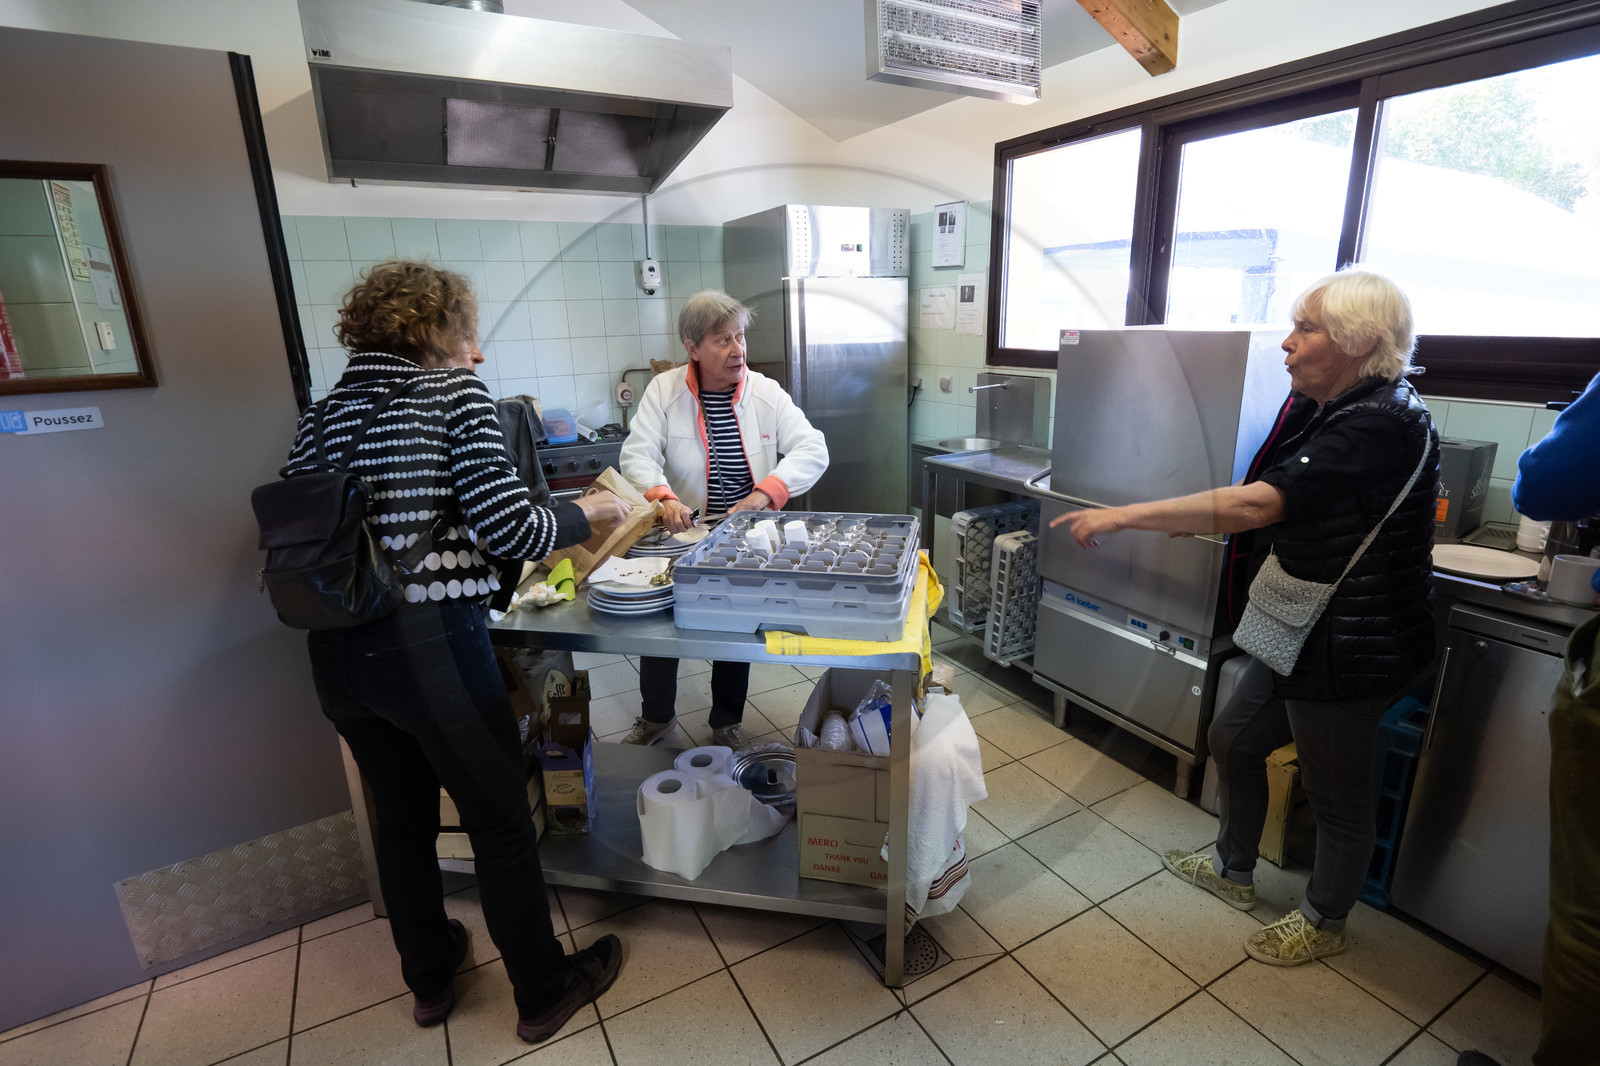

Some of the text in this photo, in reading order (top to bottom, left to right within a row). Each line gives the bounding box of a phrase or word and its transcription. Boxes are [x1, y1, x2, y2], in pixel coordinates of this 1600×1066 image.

[33, 414, 94, 427] Poussez
[807, 837, 838, 848] MERCI
[825, 852, 851, 862] THANK
[853, 856, 869, 865] YOU
[813, 863, 841, 873] DANKE
